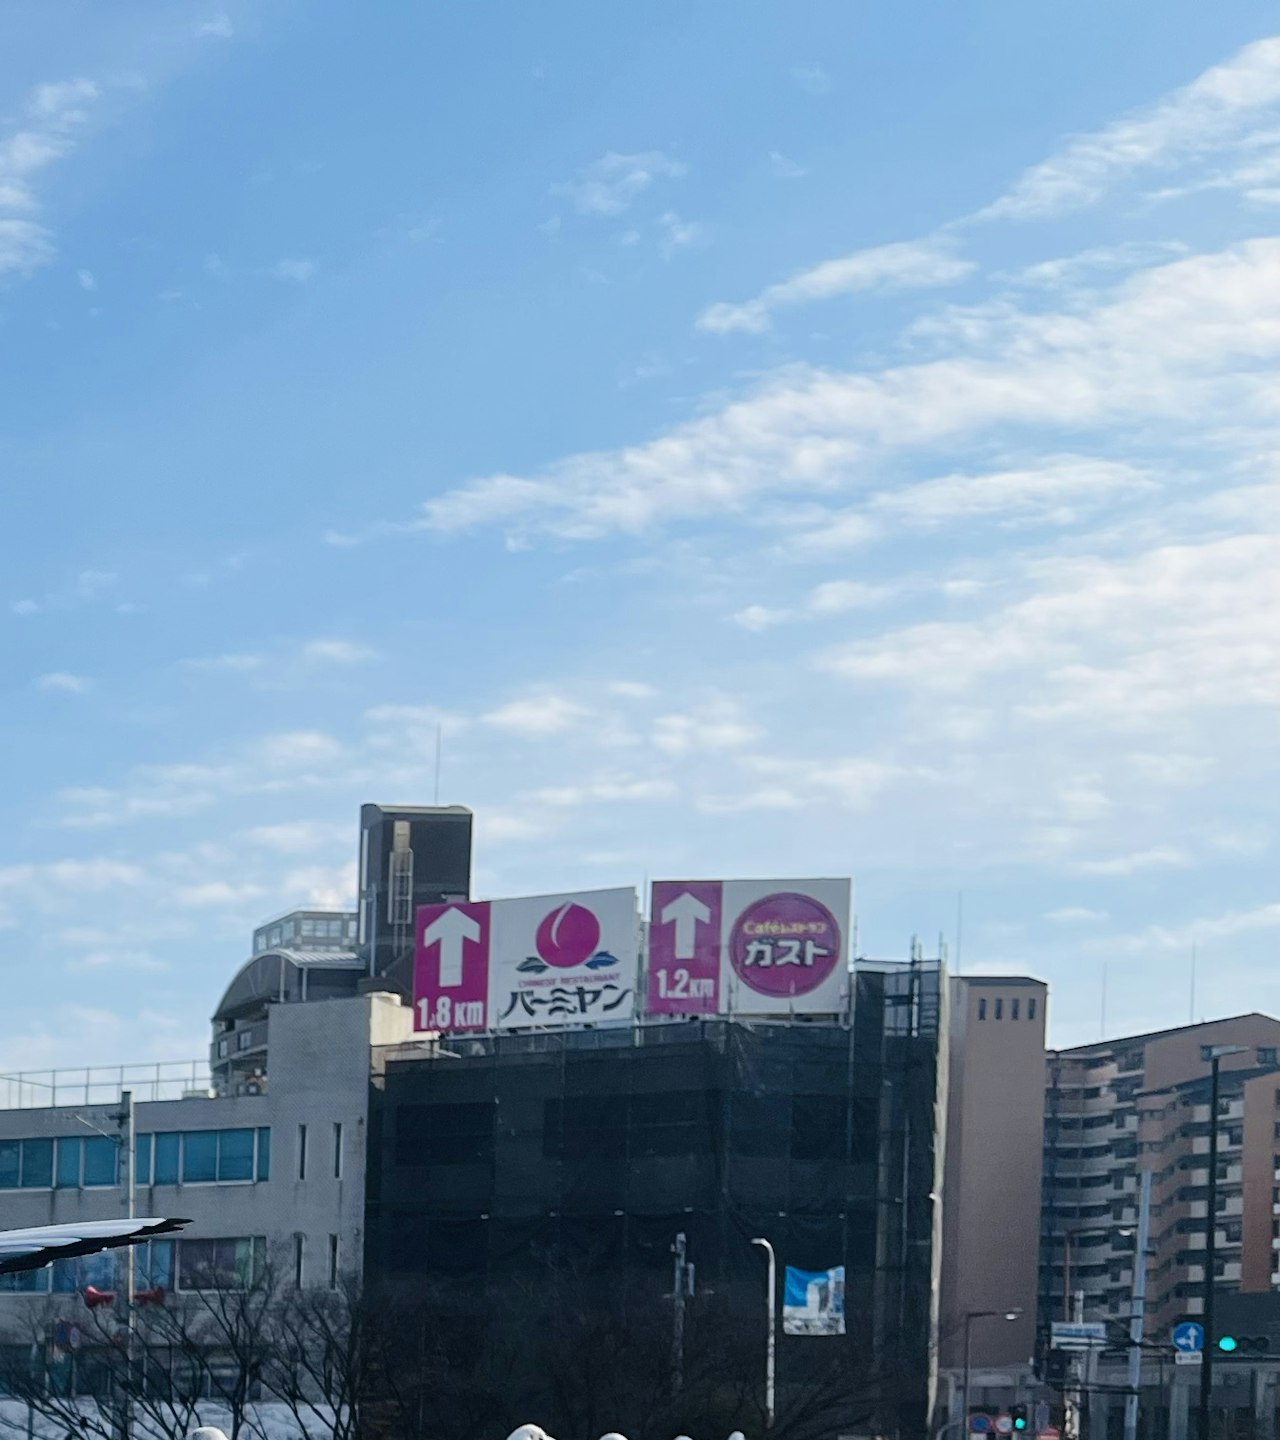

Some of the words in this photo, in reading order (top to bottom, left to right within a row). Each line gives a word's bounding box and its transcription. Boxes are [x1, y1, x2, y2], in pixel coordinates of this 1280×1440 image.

[745, 938, 829, 967] ガスト
[500, 984, 632, 1017] バーミヤン
